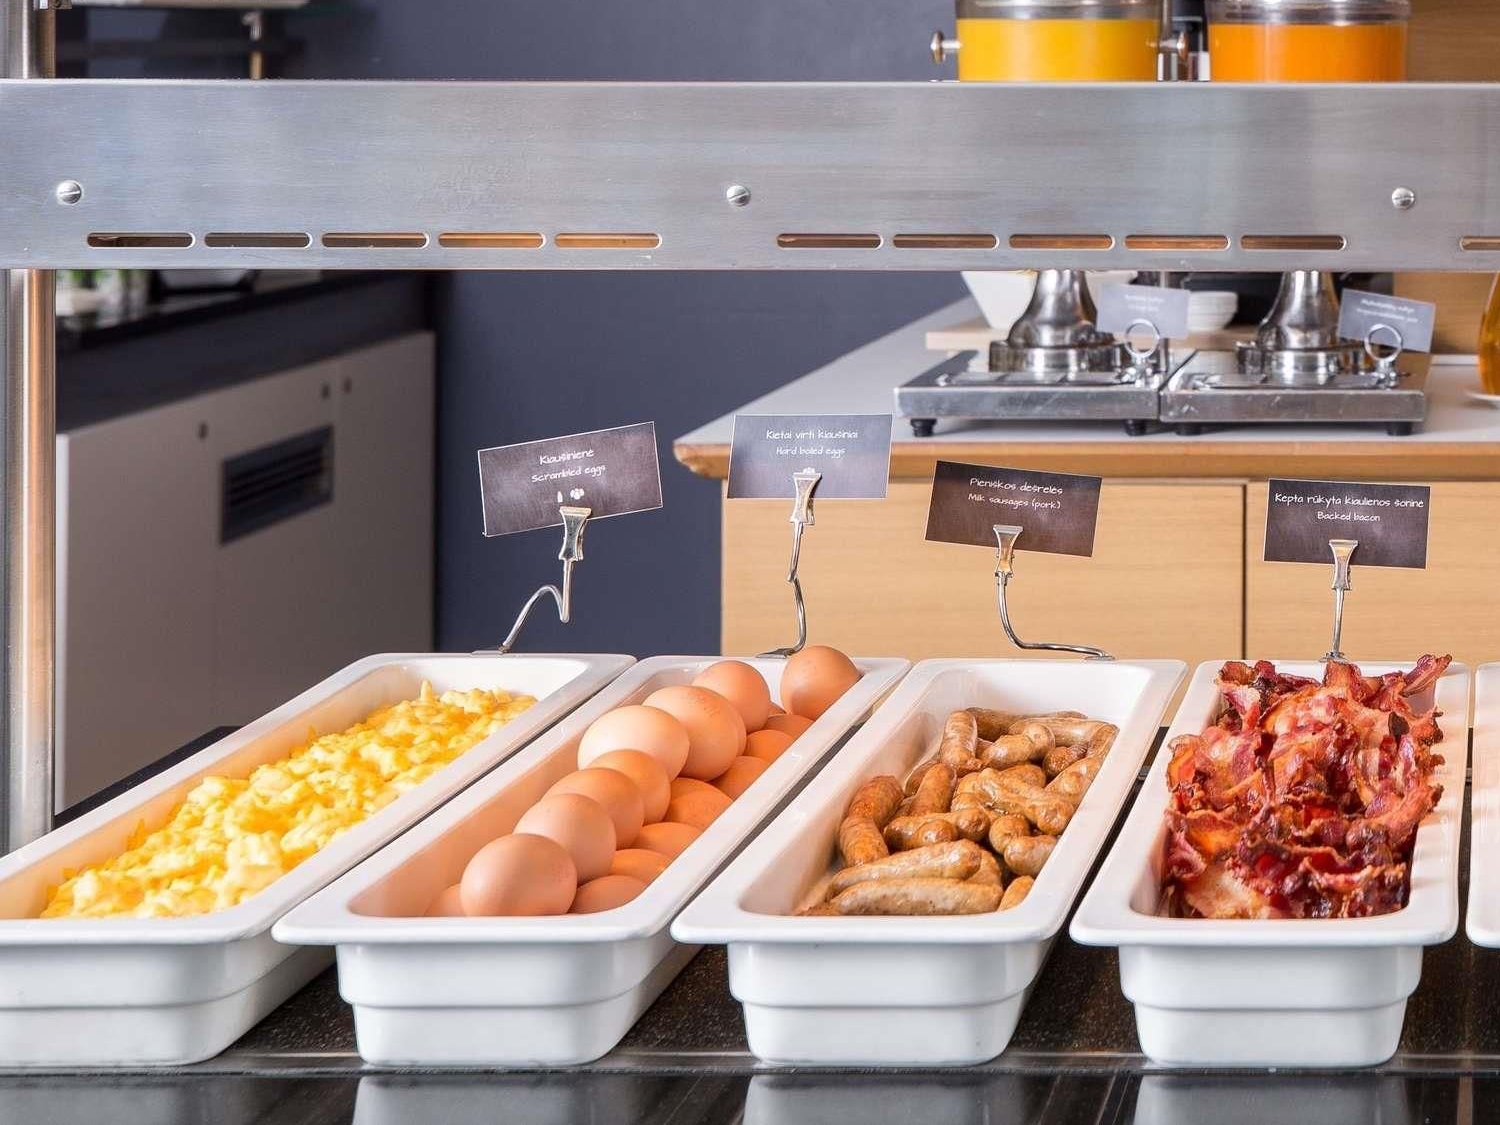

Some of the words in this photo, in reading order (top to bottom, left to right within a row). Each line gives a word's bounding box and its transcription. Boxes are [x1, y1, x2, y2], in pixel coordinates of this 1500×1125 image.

[795, 429, 815, 440] virti
[776, 446, 797, 455] Hard
[799, 446, 823, 455] boiled
[826, 448, 846, 459] eggs
[584, 465, 606, 478] eggs
[968, 493, 985, 502] Milk
[989, 496, 1029, 510] sausages
[1031, 497, 1061, 510] (pork)
[1317, 511, 1351, 521] Backed
[1353, 511, 1381, 522] bacon
